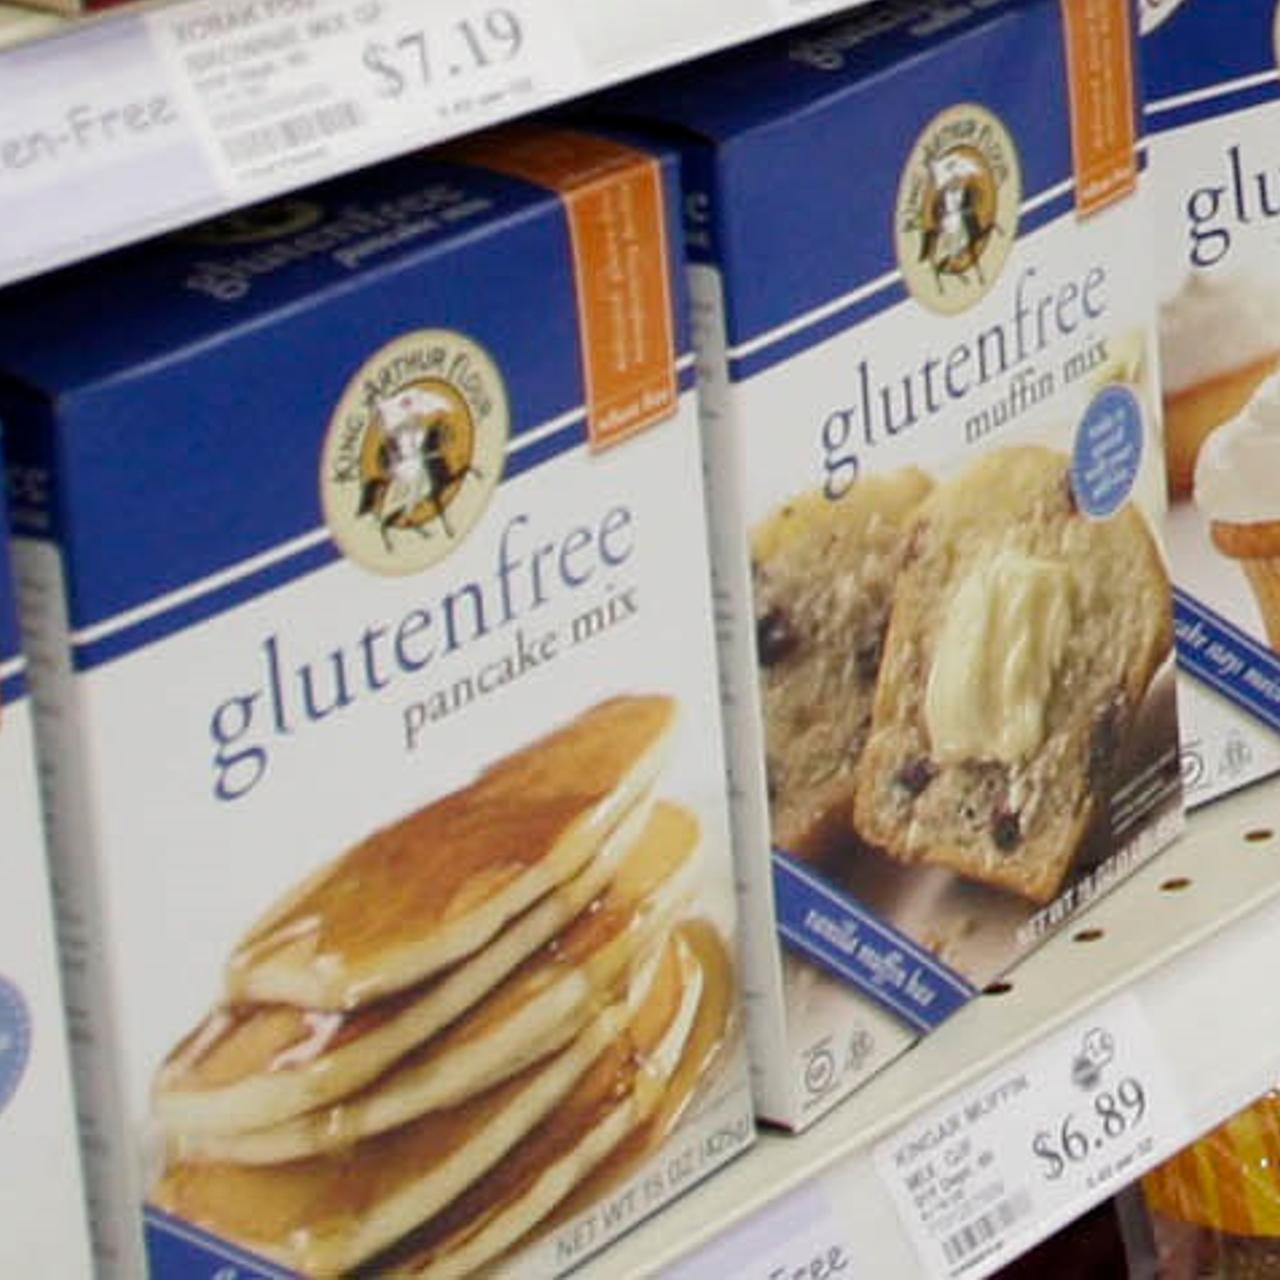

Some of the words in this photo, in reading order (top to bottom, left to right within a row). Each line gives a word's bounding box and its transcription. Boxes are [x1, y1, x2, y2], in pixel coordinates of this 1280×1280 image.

[360, 6, 525, 102] $7.19
[328, 409, 368, 485] KING
[362, 345, 449, 409] ARTHUR
[448, 355, 493, 423] FLOUR
[821, 265, 1108, 501] glutenfree
[963, 366, 1056, 445] muffin
[1063, 335, 1111, 383] mix
[208, 505, 637, 803] glutenfree
[400, 623, 559, 749] pancake
[568, 582, 639, 645] mix
[1029, 1075, 1151, 1183] $6.89
